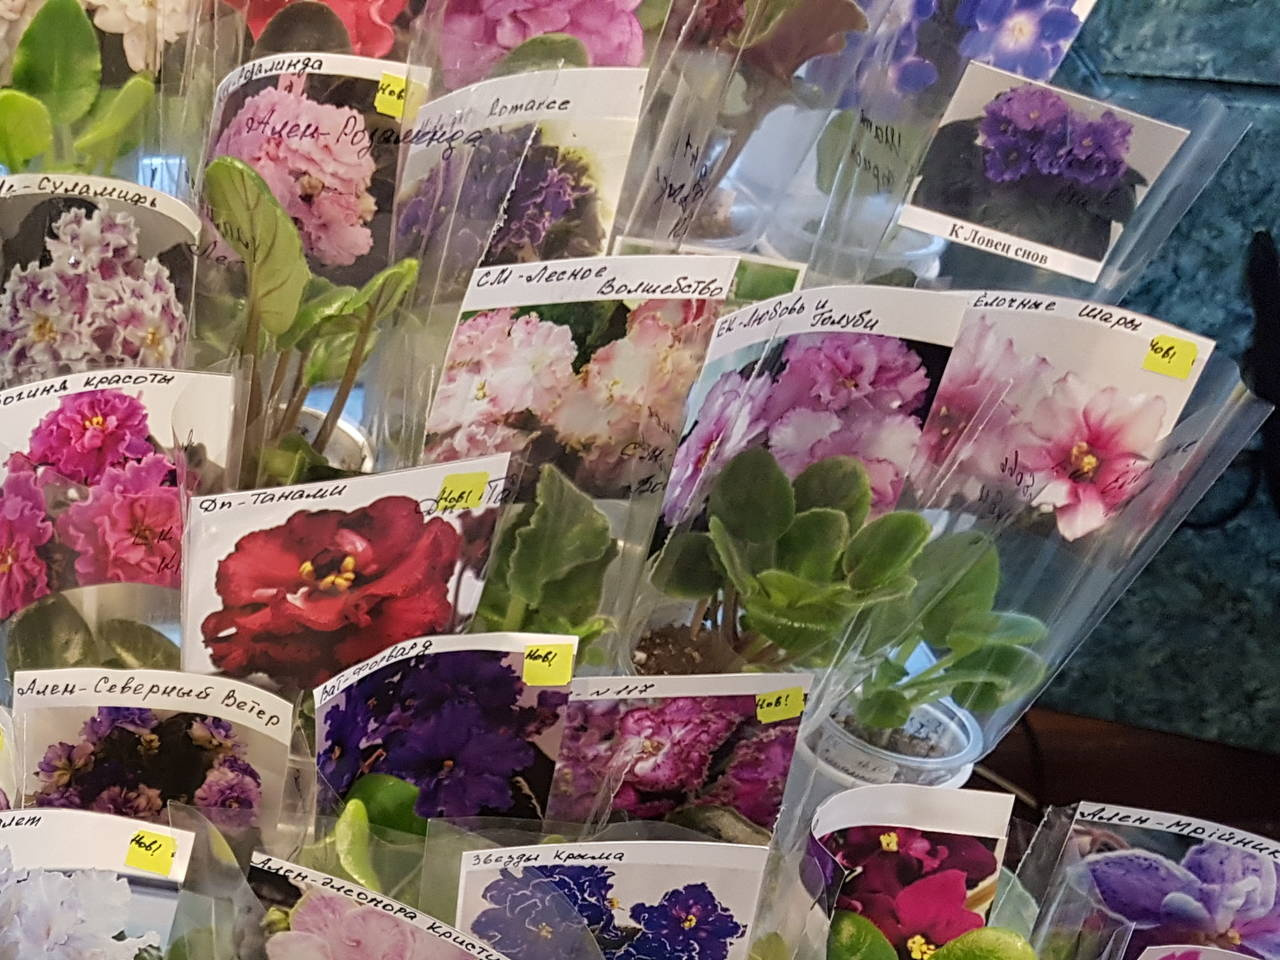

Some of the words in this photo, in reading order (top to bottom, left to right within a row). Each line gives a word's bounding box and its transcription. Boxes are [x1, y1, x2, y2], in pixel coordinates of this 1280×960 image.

[949, 223, 964, 240] К
[966, 227, 1012, 258] Ловец
[1013, 244, 1049, 267] снов
